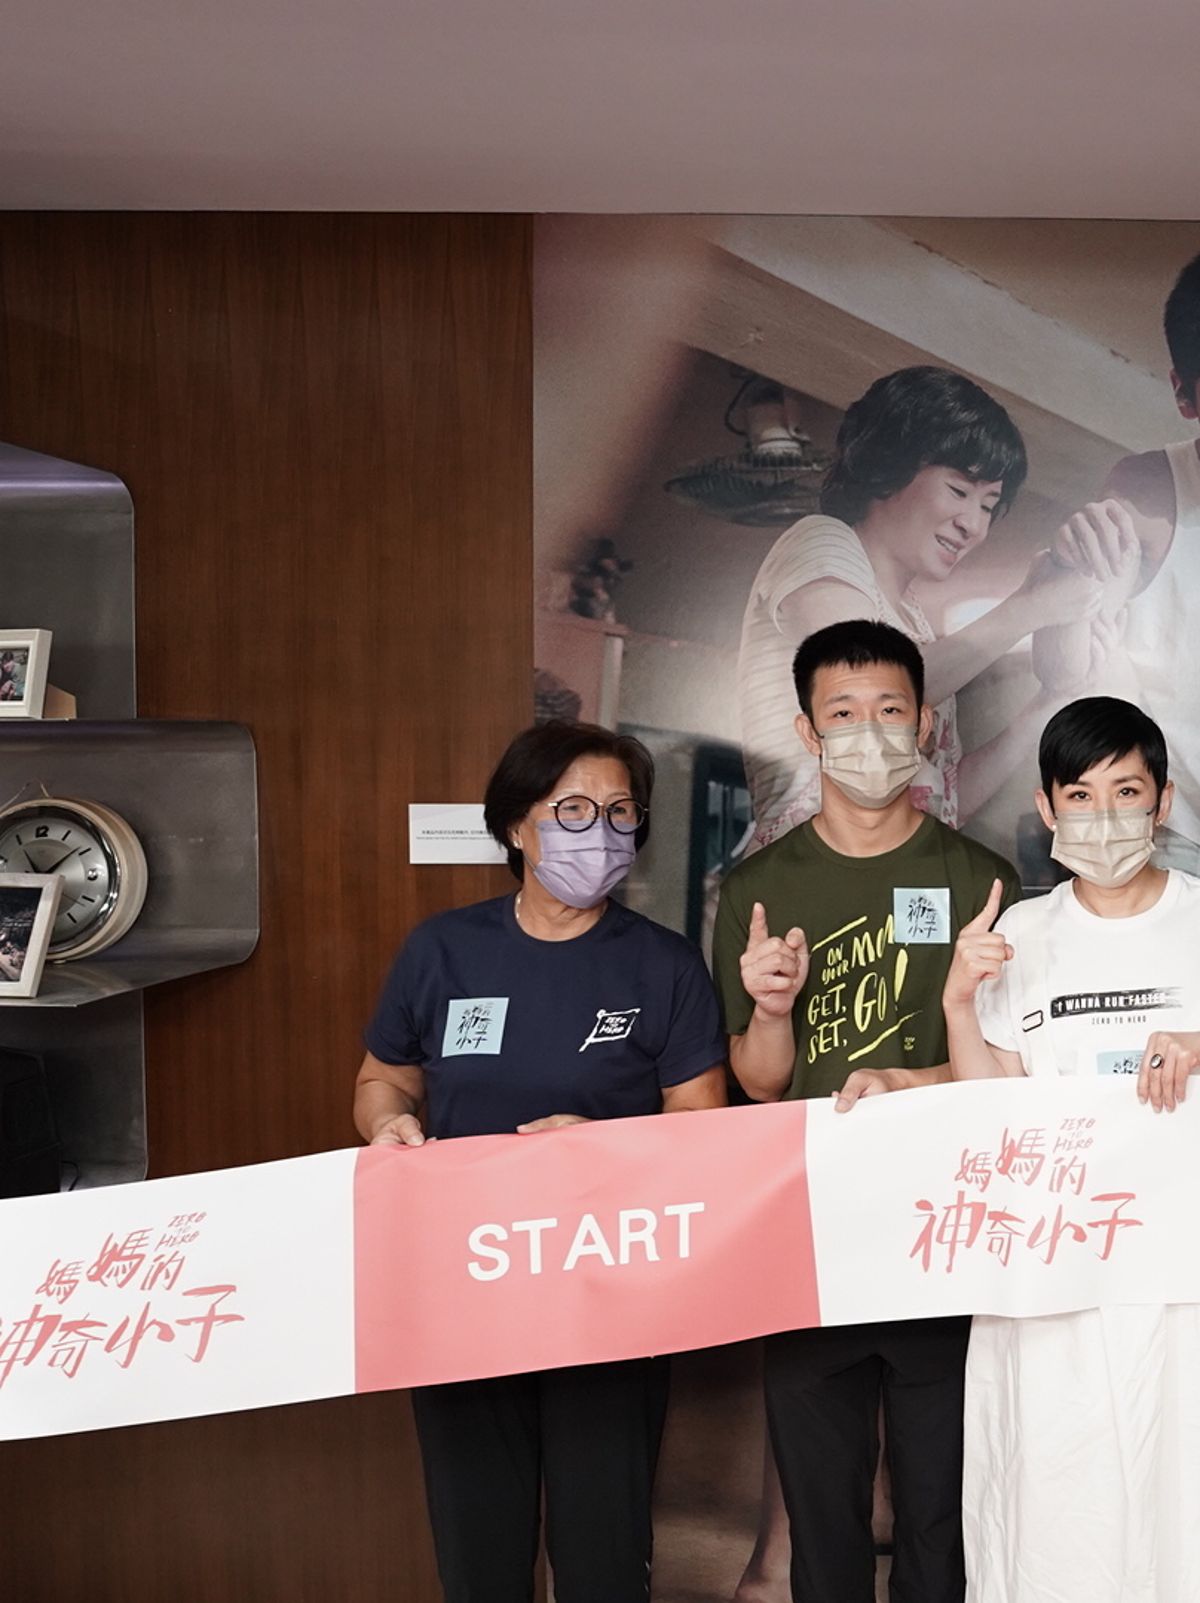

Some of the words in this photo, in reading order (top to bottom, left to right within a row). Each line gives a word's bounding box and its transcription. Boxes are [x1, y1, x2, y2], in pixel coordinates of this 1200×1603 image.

[851, 914, 895, 968] MA
[1066, 996, 1101, 1011] WANNA
[954, 1127, 1087, 1196] 媽媽的
[1053, 1136, 1094, 1153] HERO
[155, 1230, 201, 1251] HERO
[467, 1201, 705, 1282] START
[909, 1190, 1144, 1274] 神奇小子
[35, 1228, 187, 1305] 媽媽的
